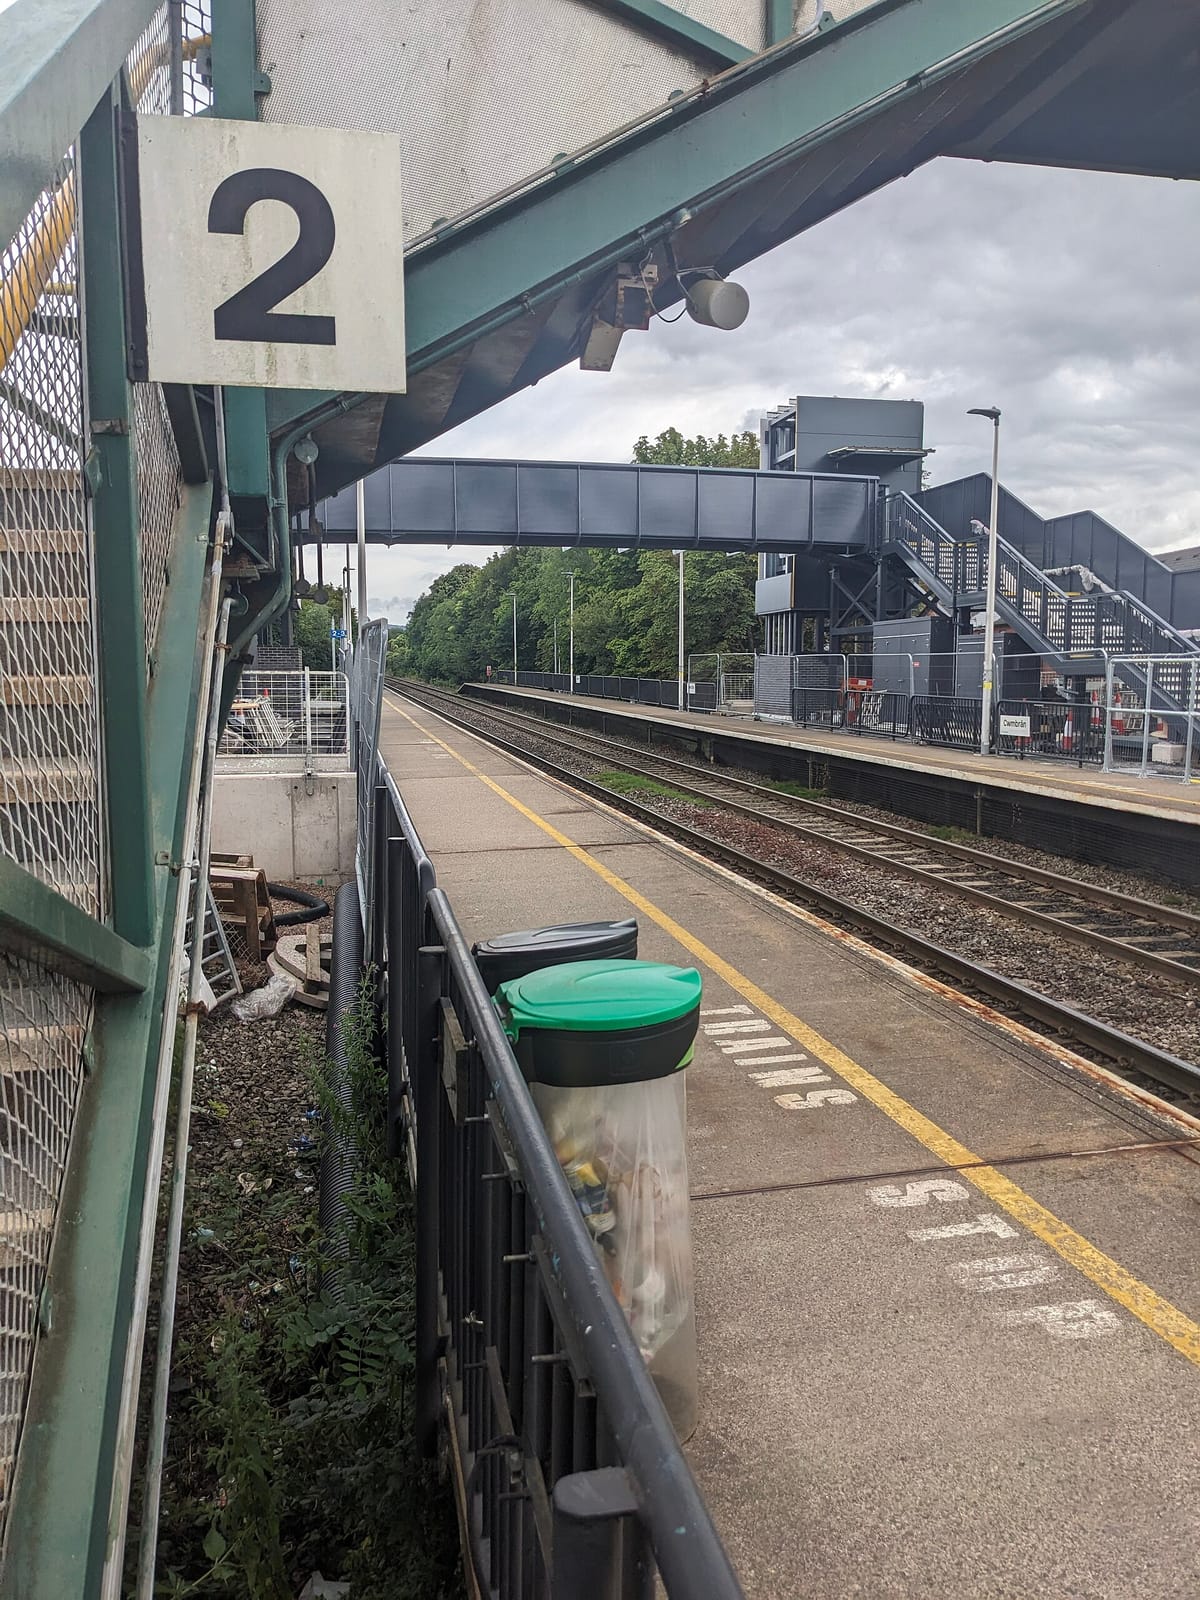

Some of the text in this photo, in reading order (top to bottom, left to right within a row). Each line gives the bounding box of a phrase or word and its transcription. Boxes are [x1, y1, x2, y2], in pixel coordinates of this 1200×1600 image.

[207, 167, 336, 346] 2
[700, 1004, 1123, 1340] TRAINS STOP
